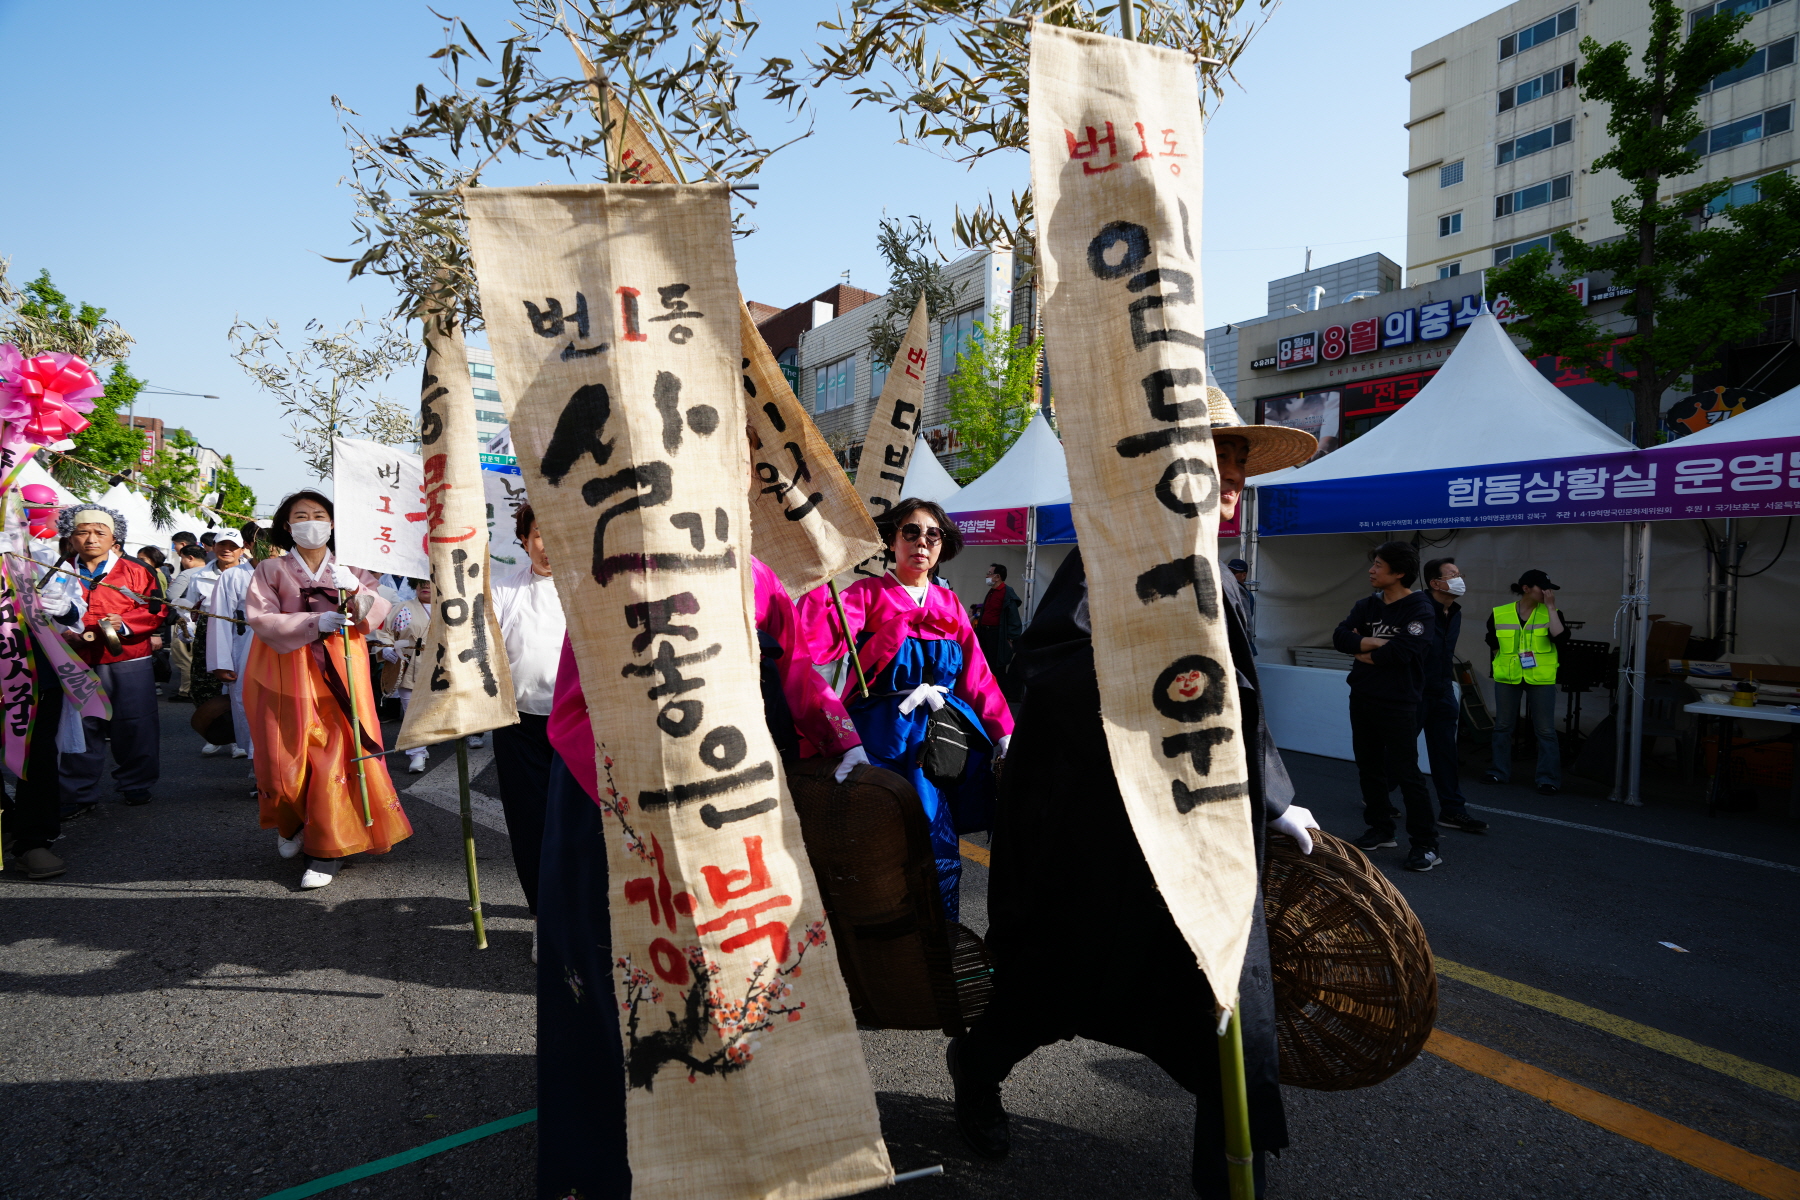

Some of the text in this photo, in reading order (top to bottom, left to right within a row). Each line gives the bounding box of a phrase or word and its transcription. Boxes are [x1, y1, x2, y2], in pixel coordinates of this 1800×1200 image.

[1329, 361, 1384, 377] CHINESE
[1448, 451, 1800, 509] 합동상황실 운영
[1685, 504, 1703, 513] 후원
